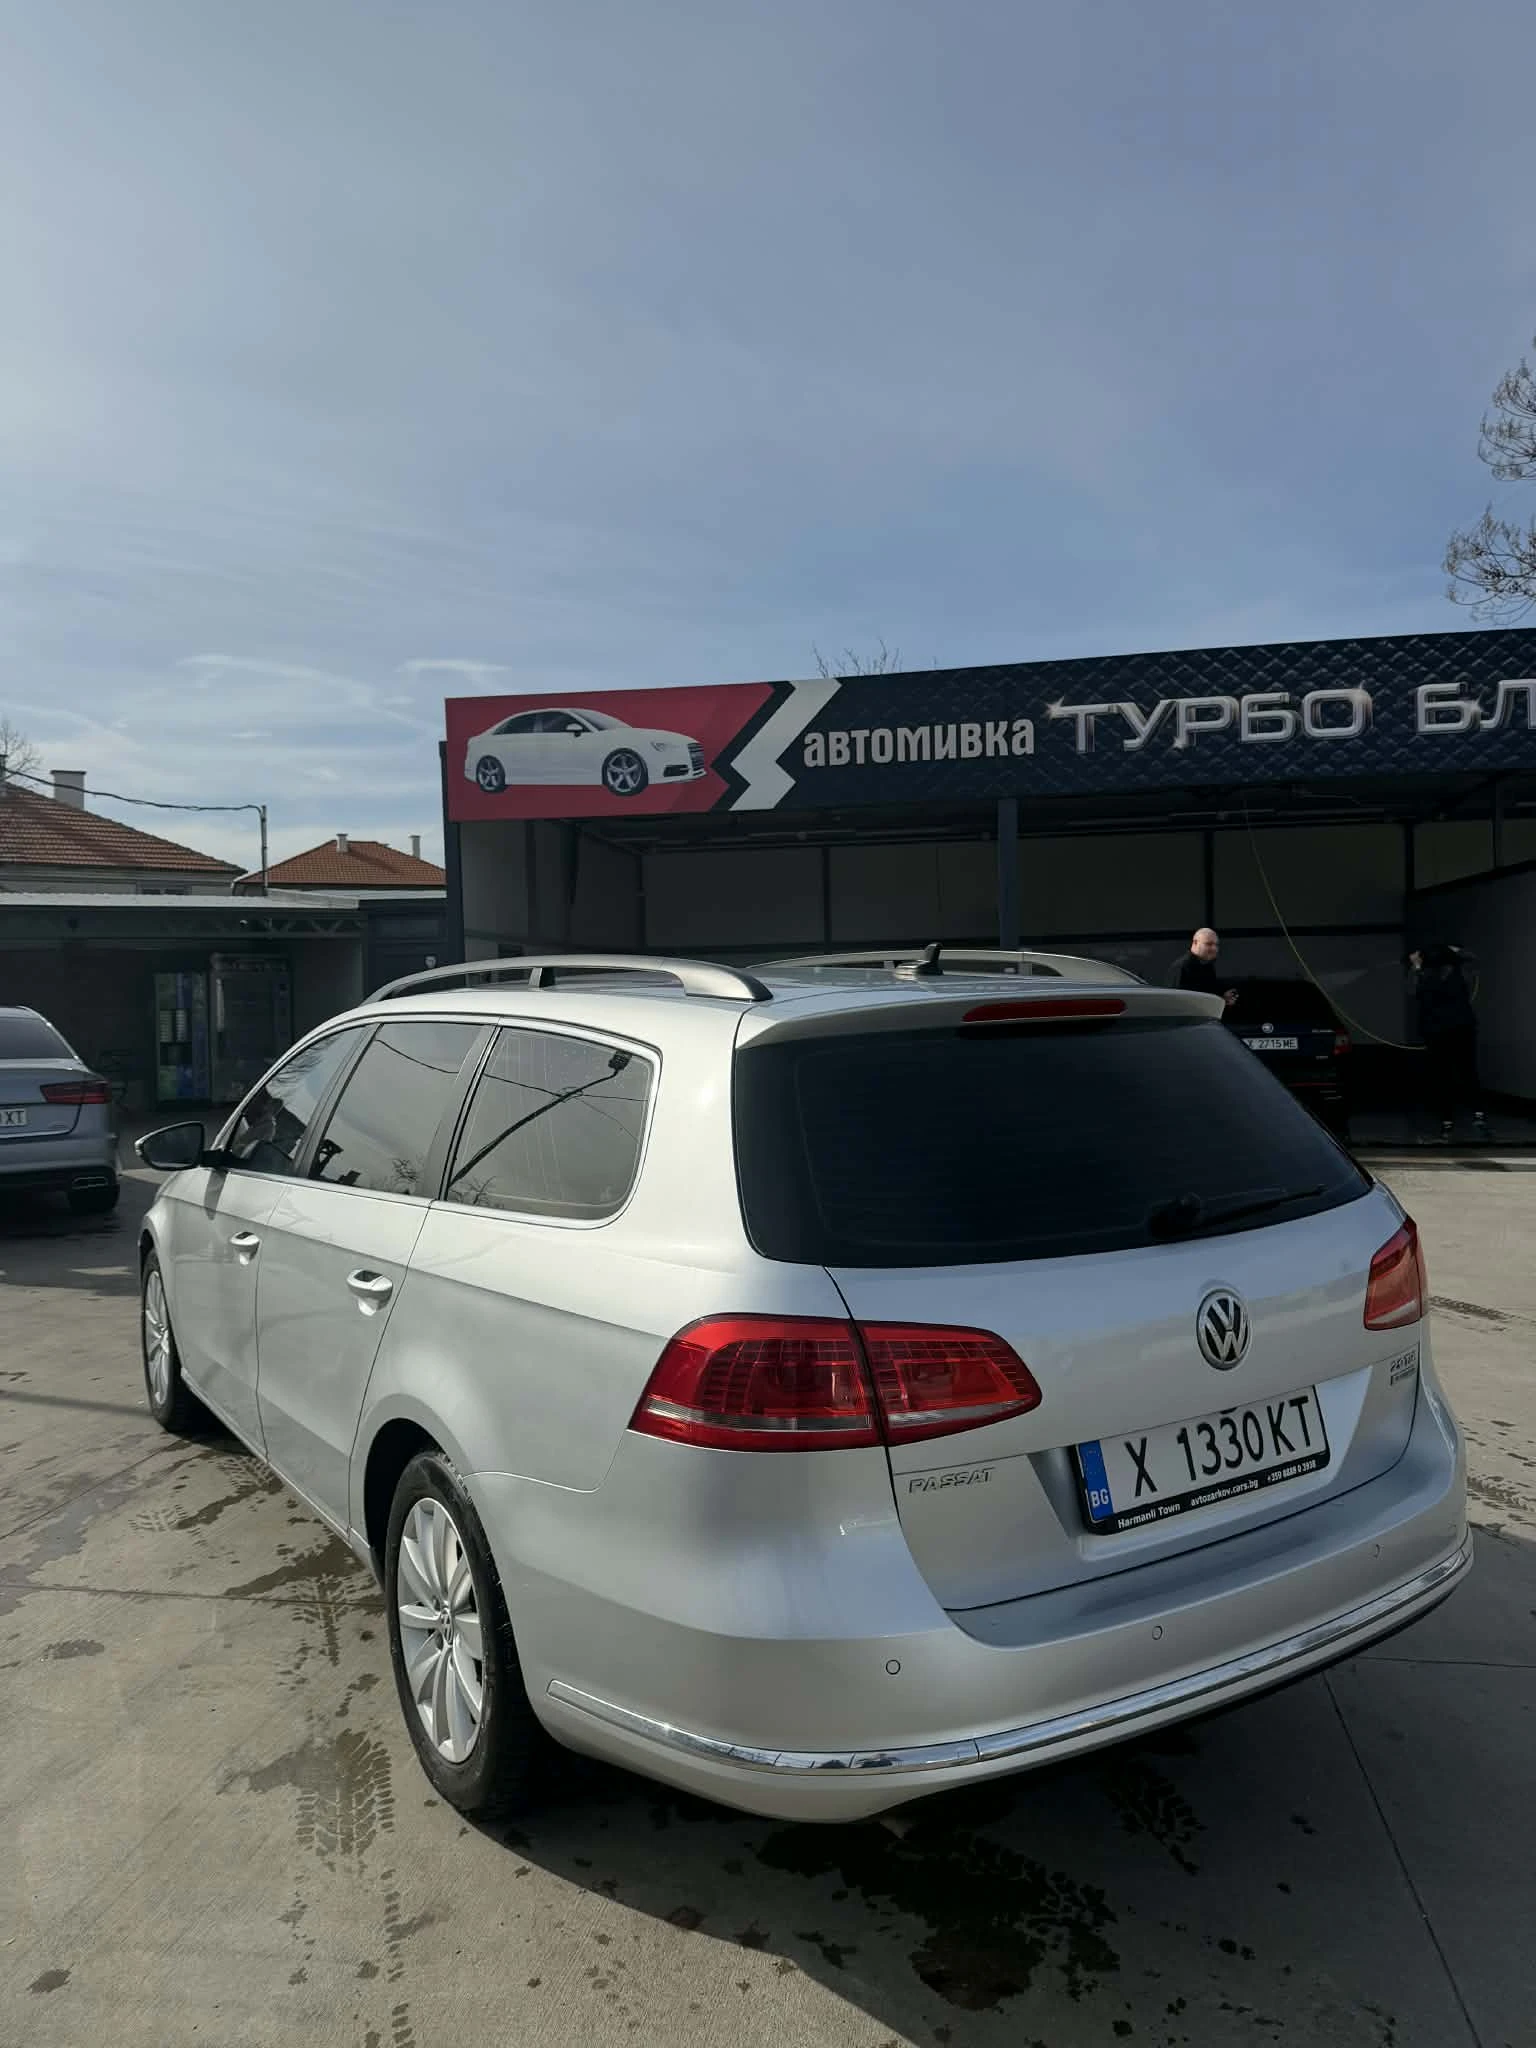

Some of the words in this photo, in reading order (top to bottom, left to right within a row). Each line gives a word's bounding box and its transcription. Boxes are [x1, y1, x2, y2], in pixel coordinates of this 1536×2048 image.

[803, 718, 1036, 768] автомивка
[1049, 688, 1373, 755] ТУРБО
[908, 1466, 996, 1494] PASSAT
[1125, 1436, 1158, 1498] X
[1090, 1488, 1110, 1508] BG
[1117, 1509, 1157, 1529] Harmanli
[1158, 1502, 1181, 1517] Town
